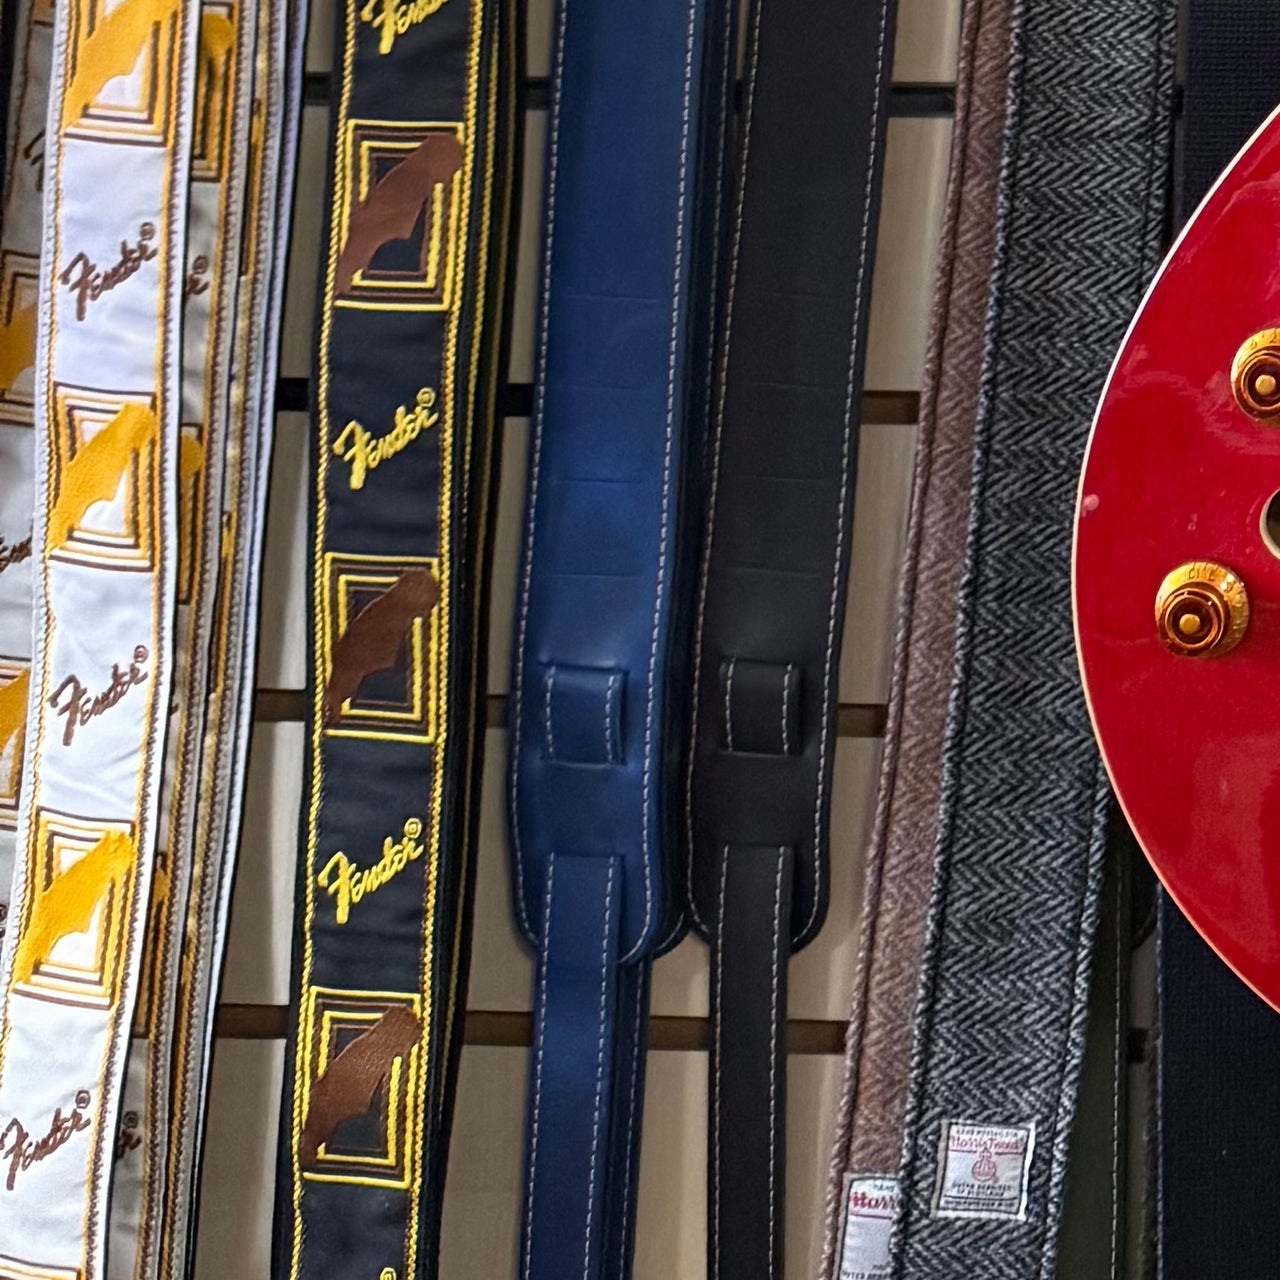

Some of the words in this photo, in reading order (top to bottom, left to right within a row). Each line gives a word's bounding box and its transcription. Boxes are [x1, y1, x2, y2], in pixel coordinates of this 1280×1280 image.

[58, 240, 158, 321] Fender
[334, 404, 438, 490] Fender
[49, 664, 150, 747] Fender
[318, 836, 424, 924] Fender
